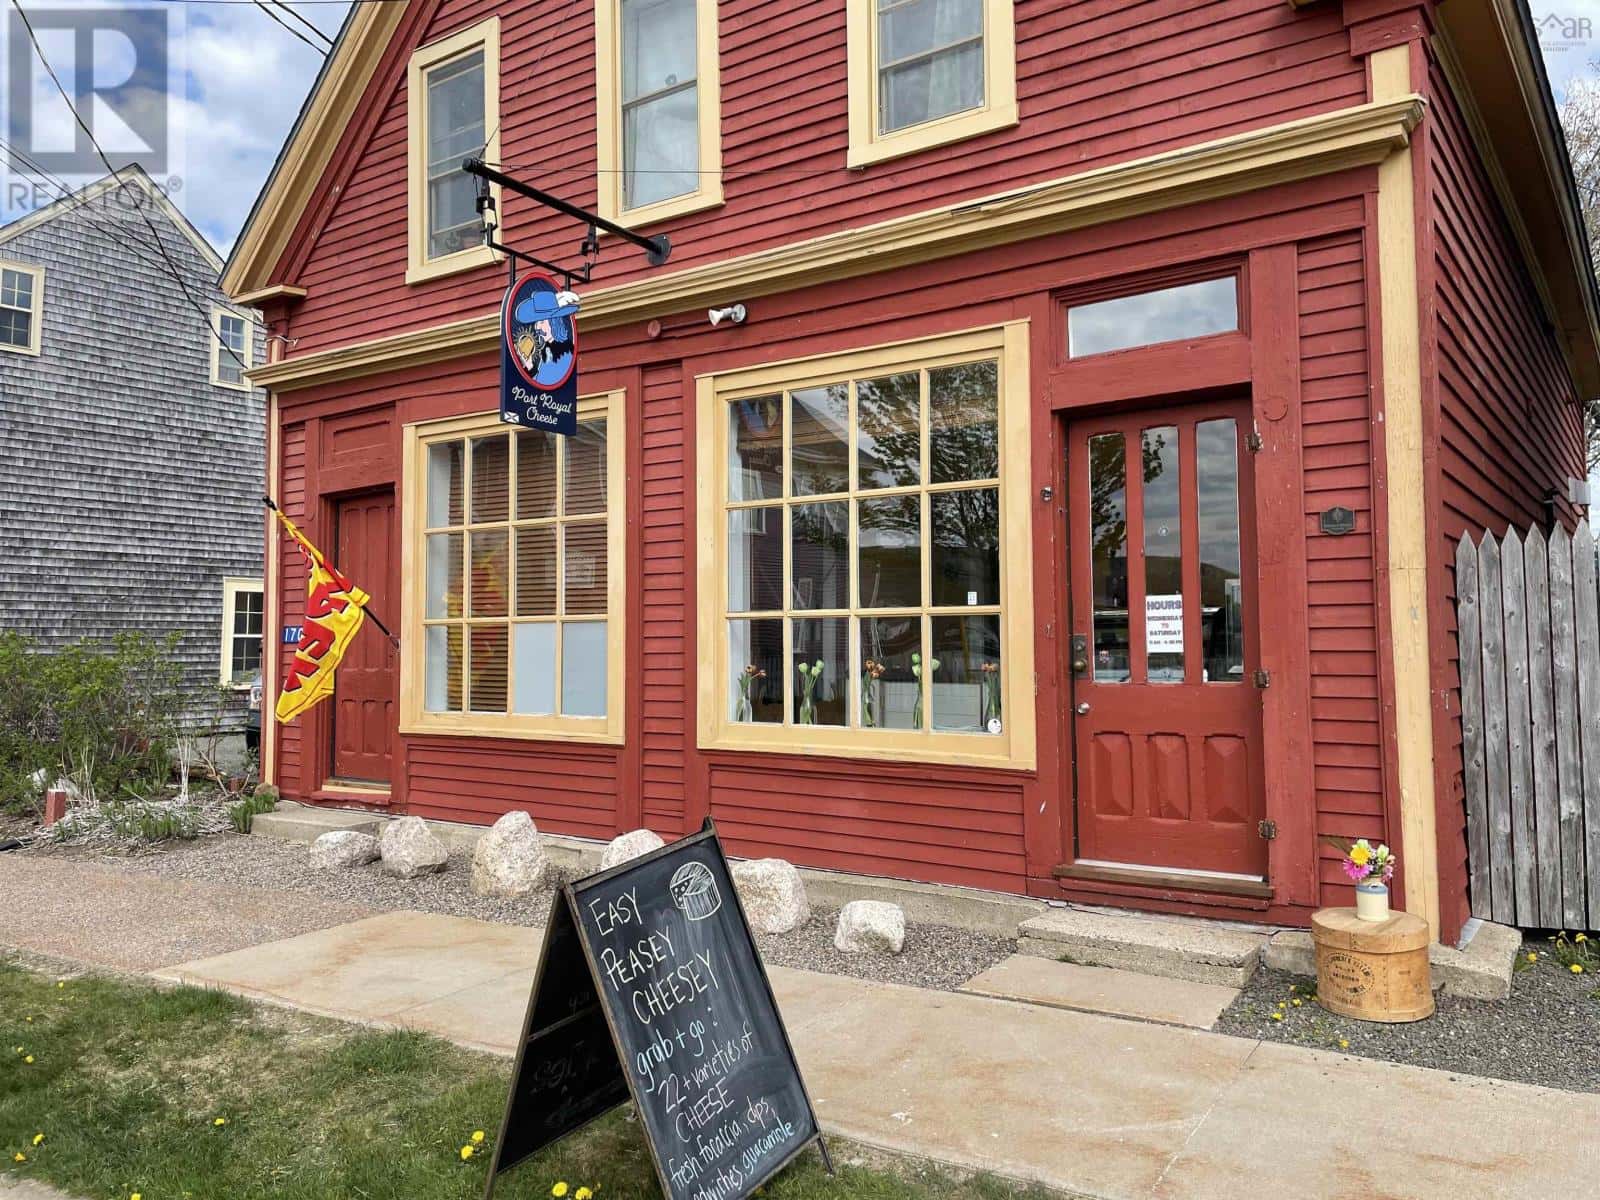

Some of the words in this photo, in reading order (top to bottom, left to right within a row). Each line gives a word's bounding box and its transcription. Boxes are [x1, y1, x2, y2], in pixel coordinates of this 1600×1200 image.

[511, 385, 538, 405] Port
[540, 392, 573, 415] Royal
[526, 406, 559, 425] Cheese
[1147, 600, 1182, 611] HOURS
[588, 886, 642, 936] EASY
[600, 925, 675, 992] PEASEY
[632, 948, 719, 1024] CHEESEY
[637, 1028, 674, 1093] grab
[658, 1073, 687, 1113] 22
[690, 1039, 741, 1089] varieties
[740, 1020, 753, 1054] of
[675, 1076, 735, 1143] CHEESE
[668, 1152, 704, 1192] fresh
[742, 1115, 795, 1175] guacamole
